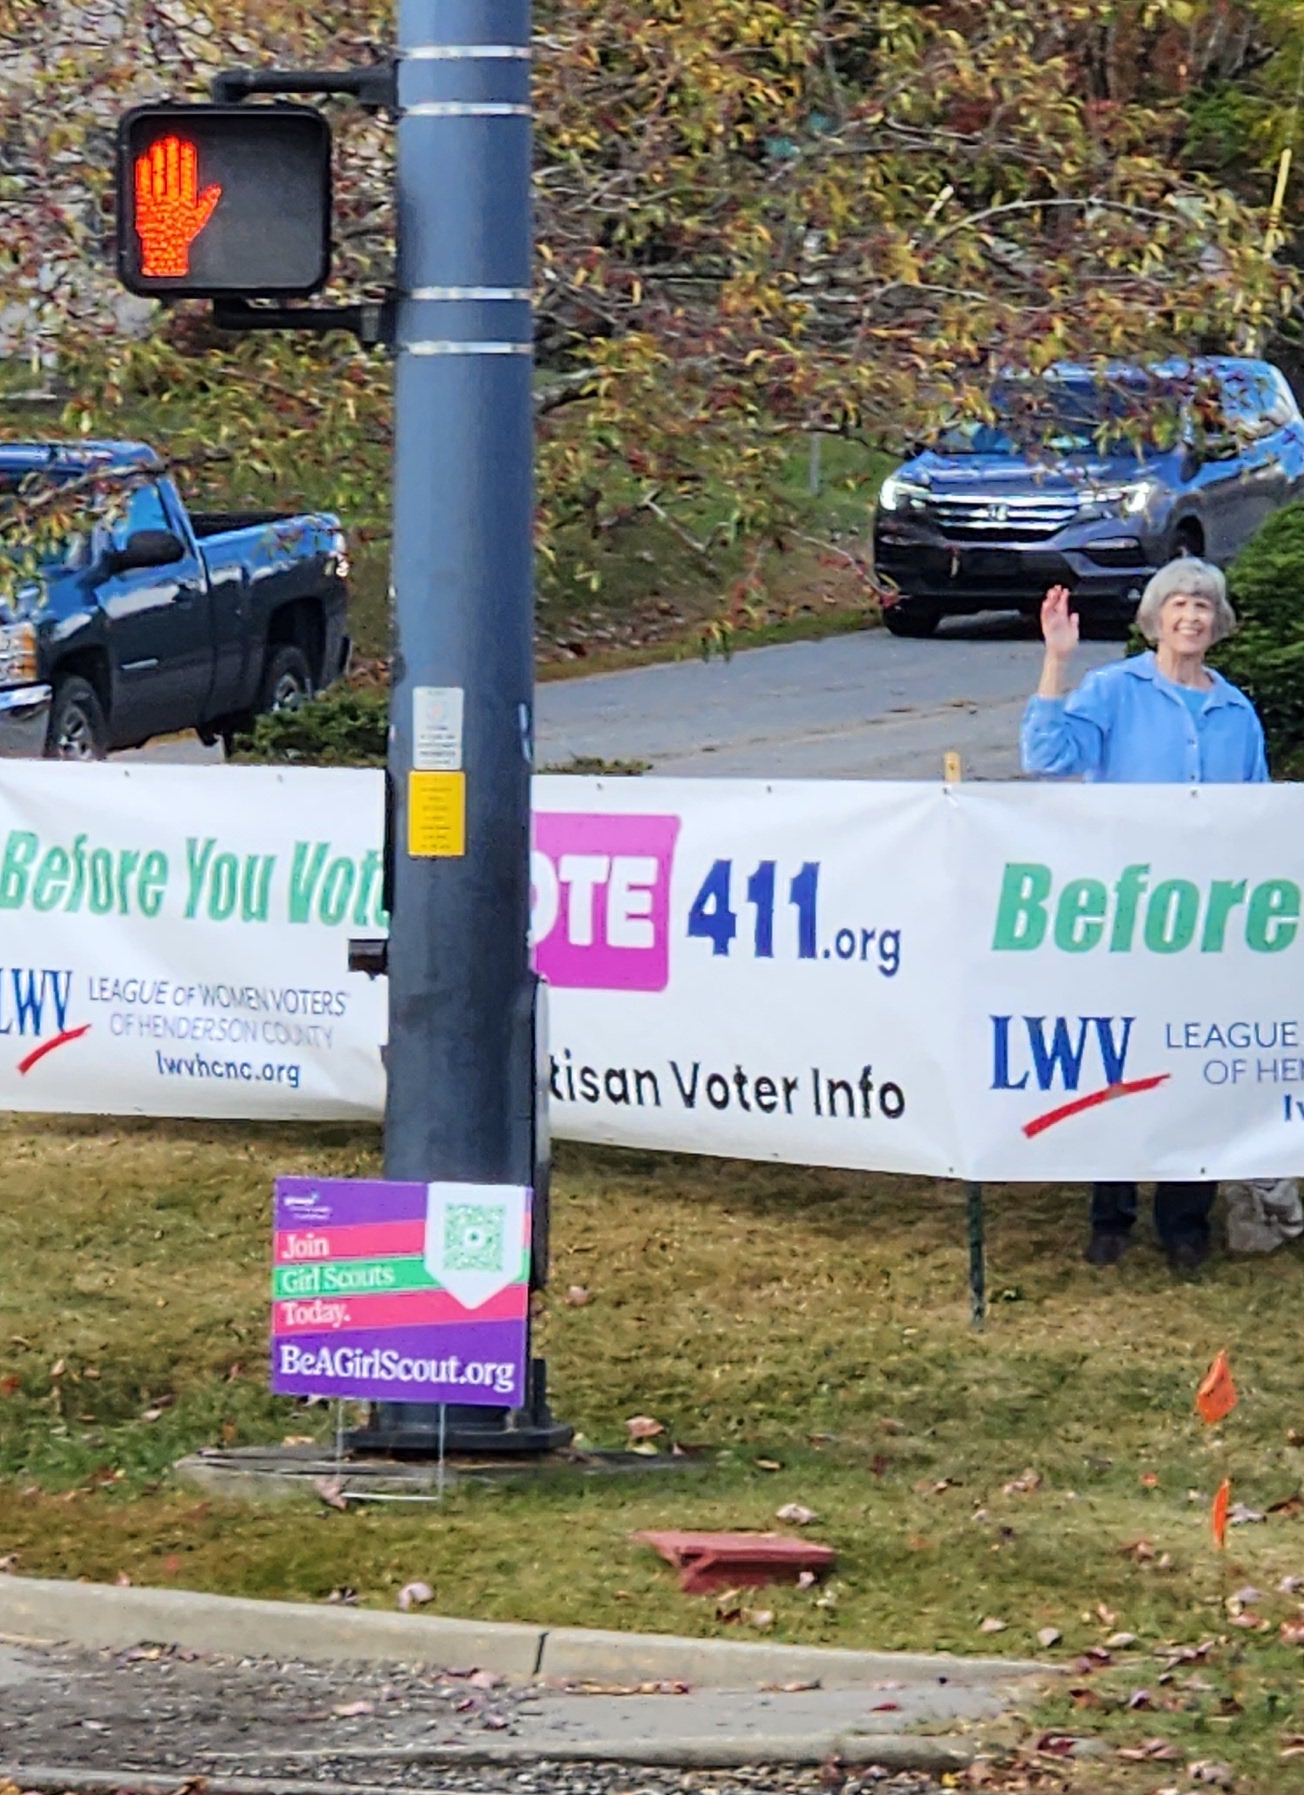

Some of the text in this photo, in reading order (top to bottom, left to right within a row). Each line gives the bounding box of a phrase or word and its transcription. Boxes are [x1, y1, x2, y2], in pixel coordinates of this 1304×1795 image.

[0, 829, 169, 919] Before
[183, 837, 277, 923] You
[530, 851, 901, 978] TE 411.org
[991, 862, 1302, 954] Before
[89, 976, 346, 1017] LEAGUE OF WOMEN VOTERS
[110, 1012, 334, 1050] OF HENDERSON COUNTY
[1166, 1021, 1298, 1050] LEAGUE
[156, 1049, 300, 1088] lwvhcnc.org
[989, 1015, 1136, 1091] LWV
[1203, 1061, 1247, 1085] OF
[668, 1059, 799, 1114] Voter
[812, 1063, 906, 1119] Info
[282, 1233, 330, 1260] Join
[282, 1266, 396, 1293] Girl Scouts
[281, 1300, 351, 1329] Today.
[280, 1345, 515, 1392] BeAGirlScout.org
